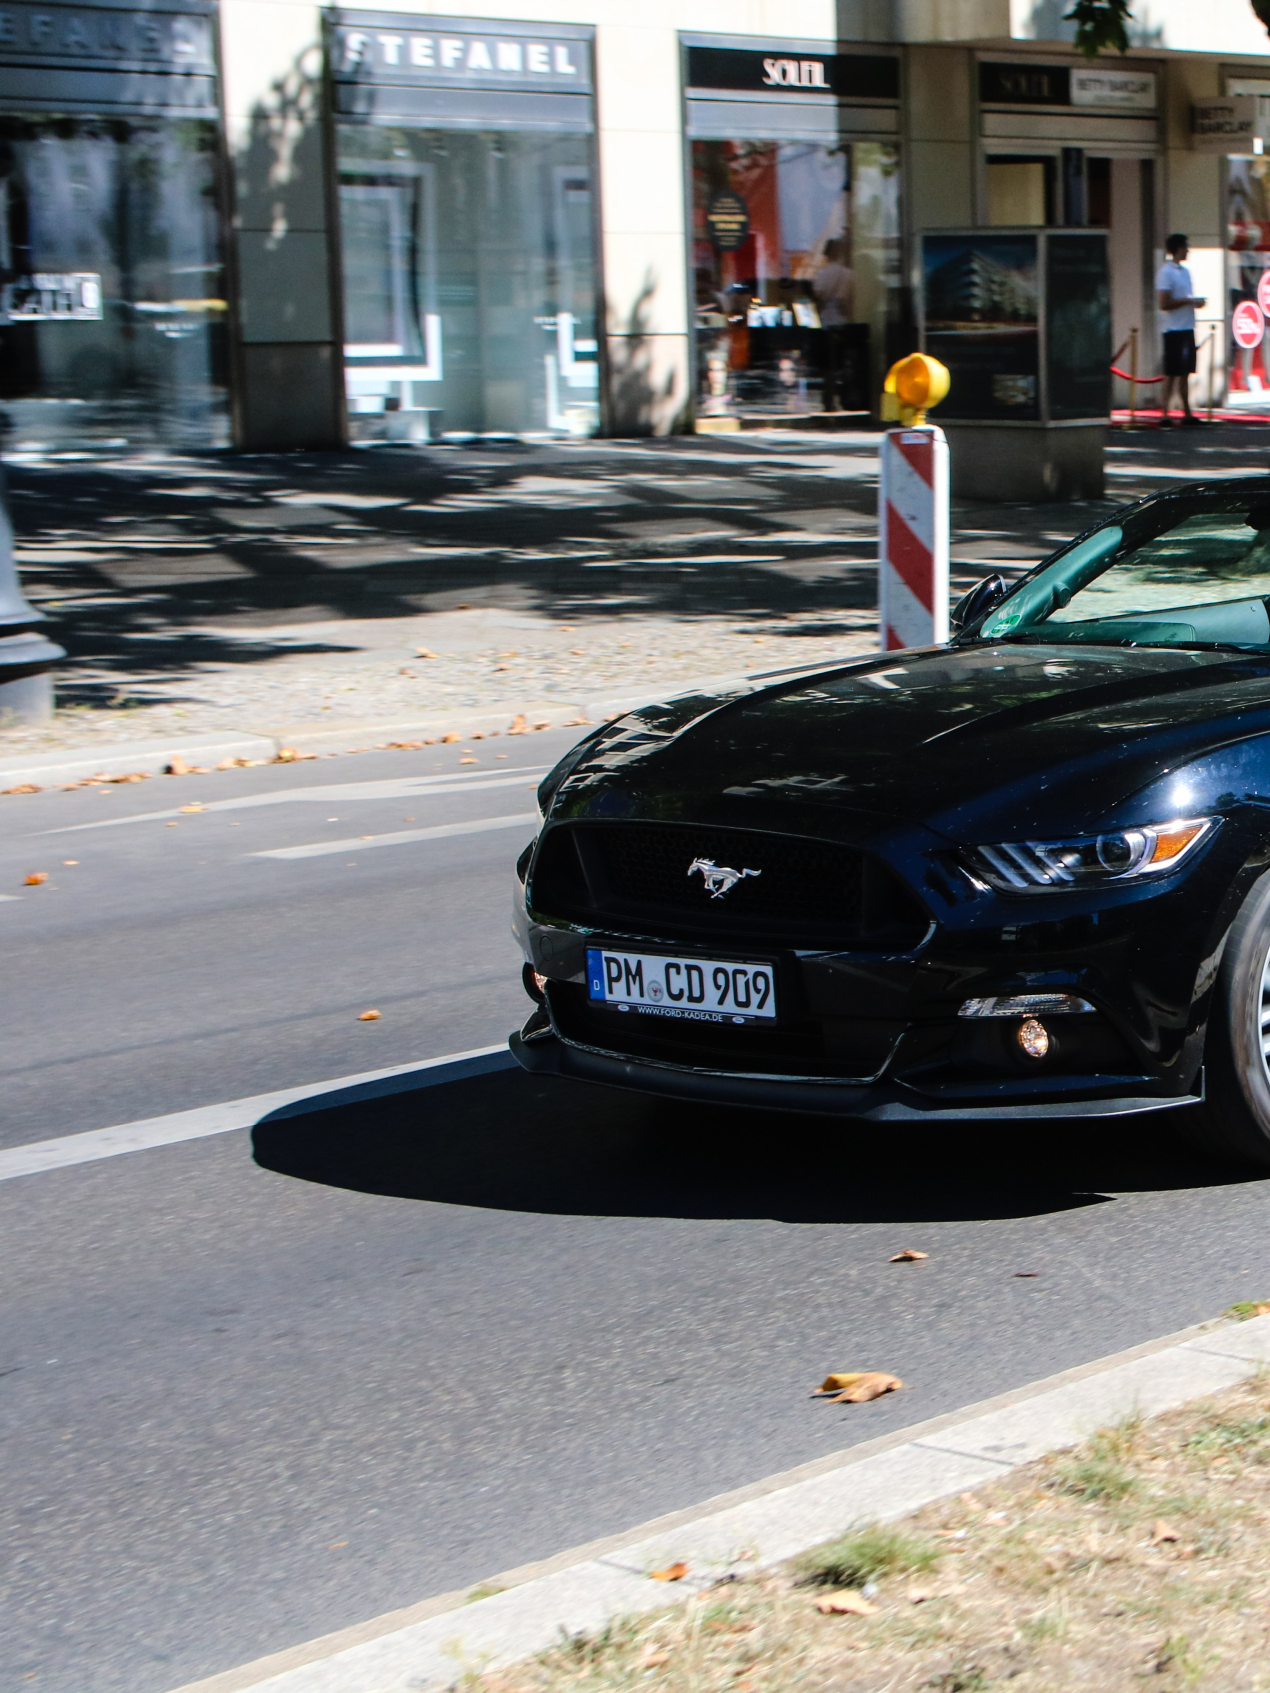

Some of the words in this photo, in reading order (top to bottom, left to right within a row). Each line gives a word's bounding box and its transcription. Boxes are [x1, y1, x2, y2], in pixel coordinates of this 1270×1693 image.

[345, 32, 577, 75] STEFANEL
[1198, 106, 1234, 120] BETTY
[1198, 121, 1252, 134] BARCLAY
[593, 979, 600, 991] D
[604, 956, 644, 998] PM
[664, 962, 705, 1004] CD
[712, 967, 770, 1010] 909
[637, 1005, 723, 1022] WWW.FORD-KADEA.DE
